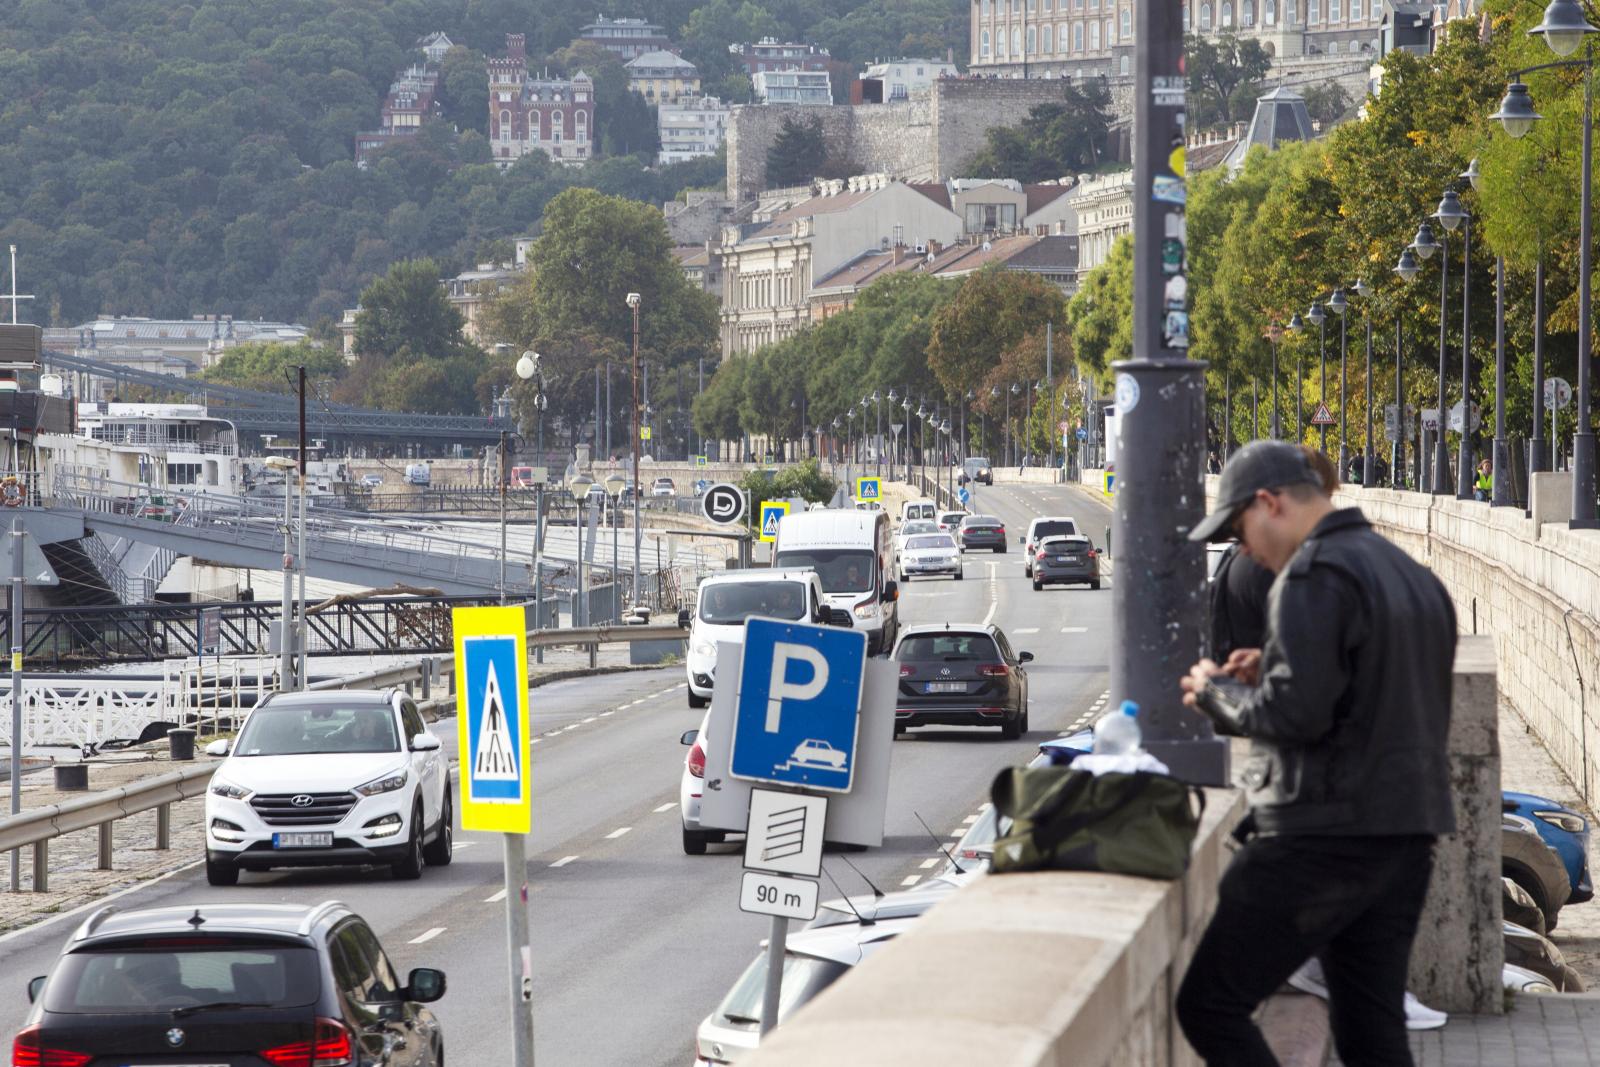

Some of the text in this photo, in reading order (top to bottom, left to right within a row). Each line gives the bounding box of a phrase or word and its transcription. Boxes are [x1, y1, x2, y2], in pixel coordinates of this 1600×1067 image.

[765, 641, 829, 733] P
[757, 884, 801, 908] 90 m
